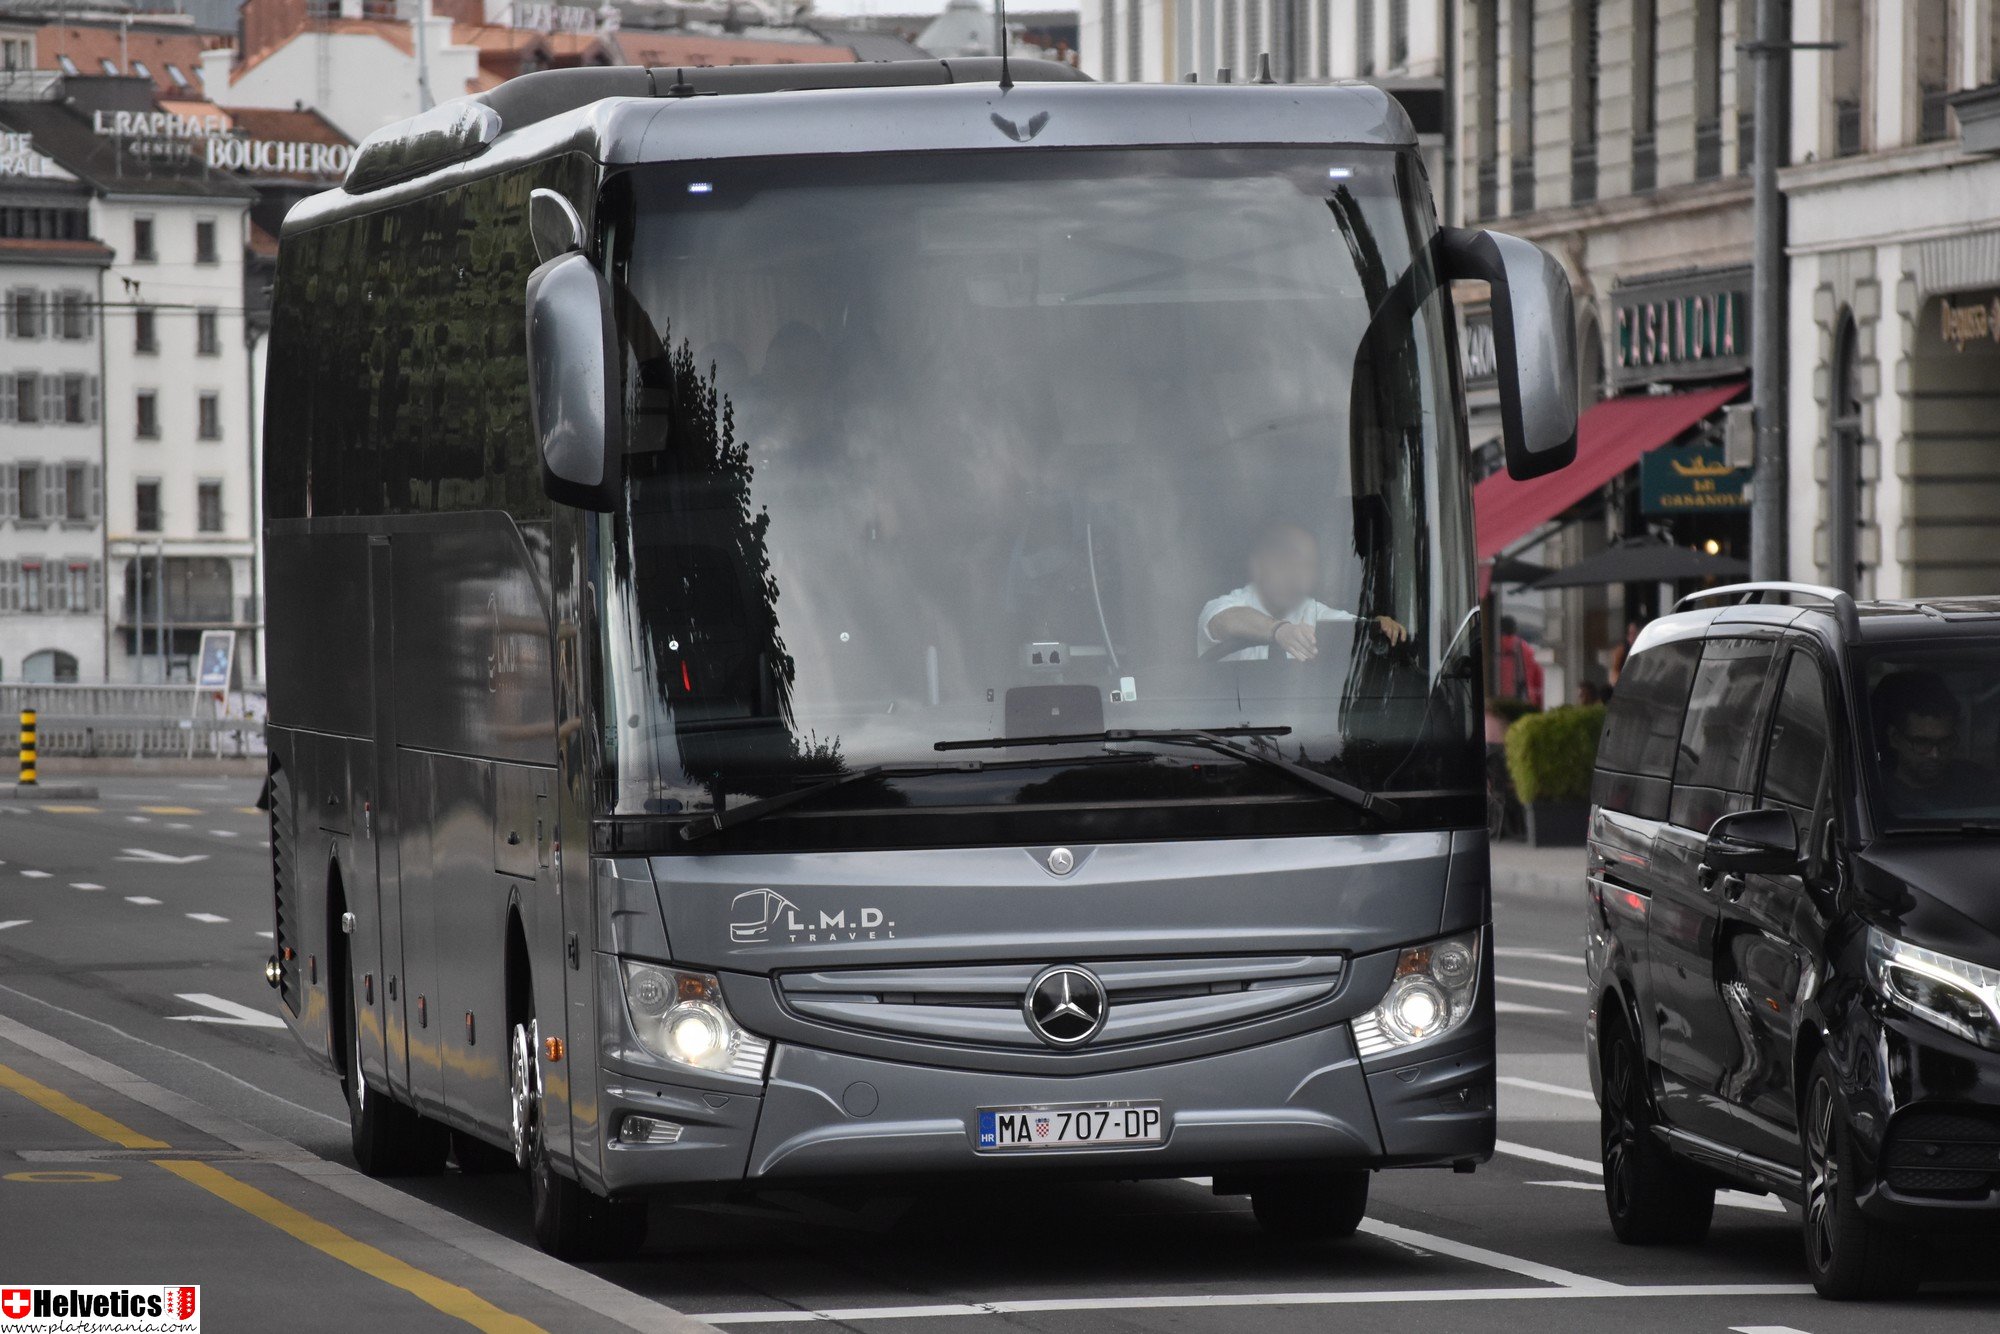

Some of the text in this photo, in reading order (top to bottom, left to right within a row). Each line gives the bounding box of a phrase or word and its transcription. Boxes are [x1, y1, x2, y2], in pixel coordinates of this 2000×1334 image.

[1616, 291, 1735, 367] CASANOVA
[788, 908, 895, 930] L.M.D.
[790, 931, 895, 942] TRAVEL
[981, 1133, 995, 1142] HR
[999, 1115, 1033, 1143] MA
